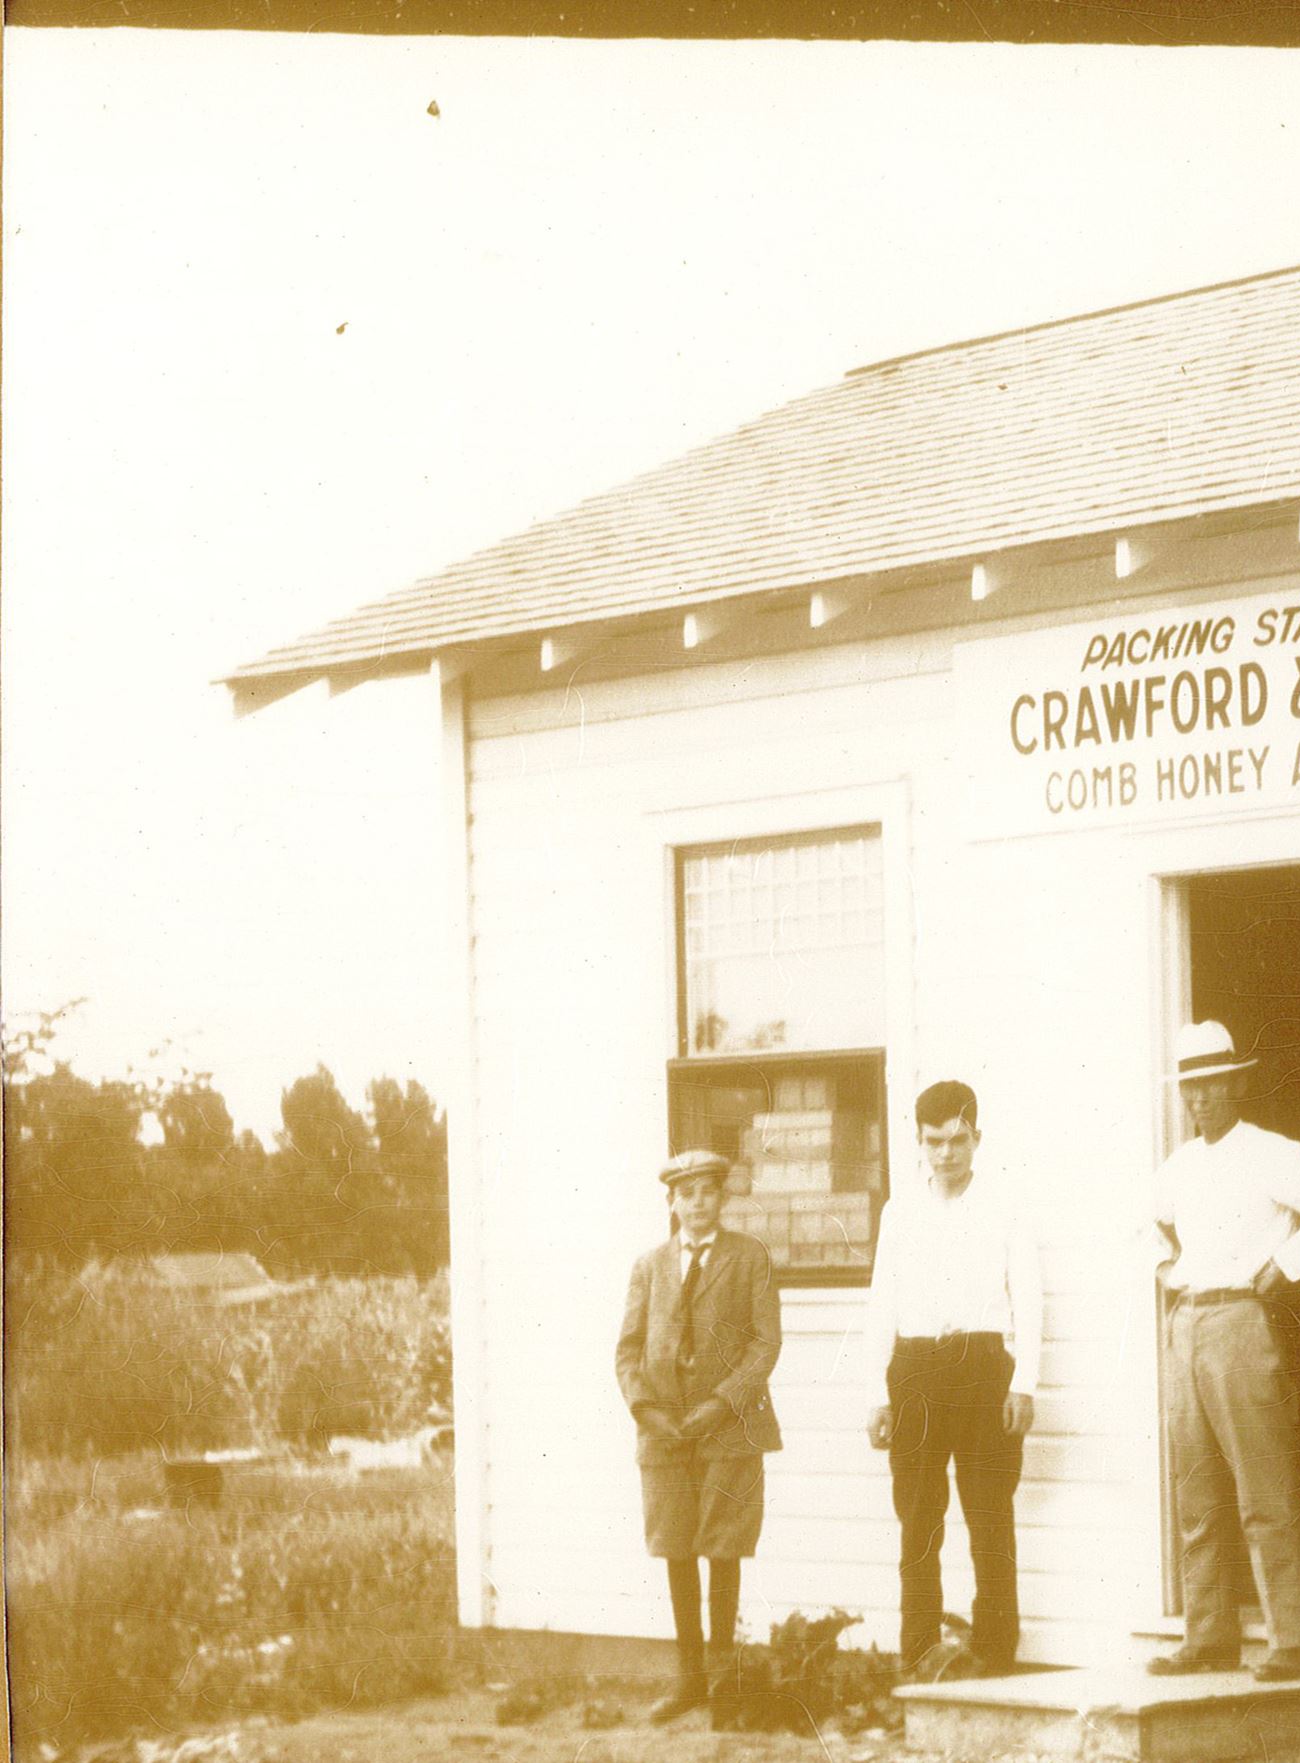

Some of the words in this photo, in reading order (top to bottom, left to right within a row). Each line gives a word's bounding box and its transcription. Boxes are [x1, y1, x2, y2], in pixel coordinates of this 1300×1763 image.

[1081, 616, 1235, 672] PACKING
[1011, 662, 1268, 755] CRAWFORD
[1046, 763, 1136, 813] COMB
[1157, 746, 1269, 800] HONEY
